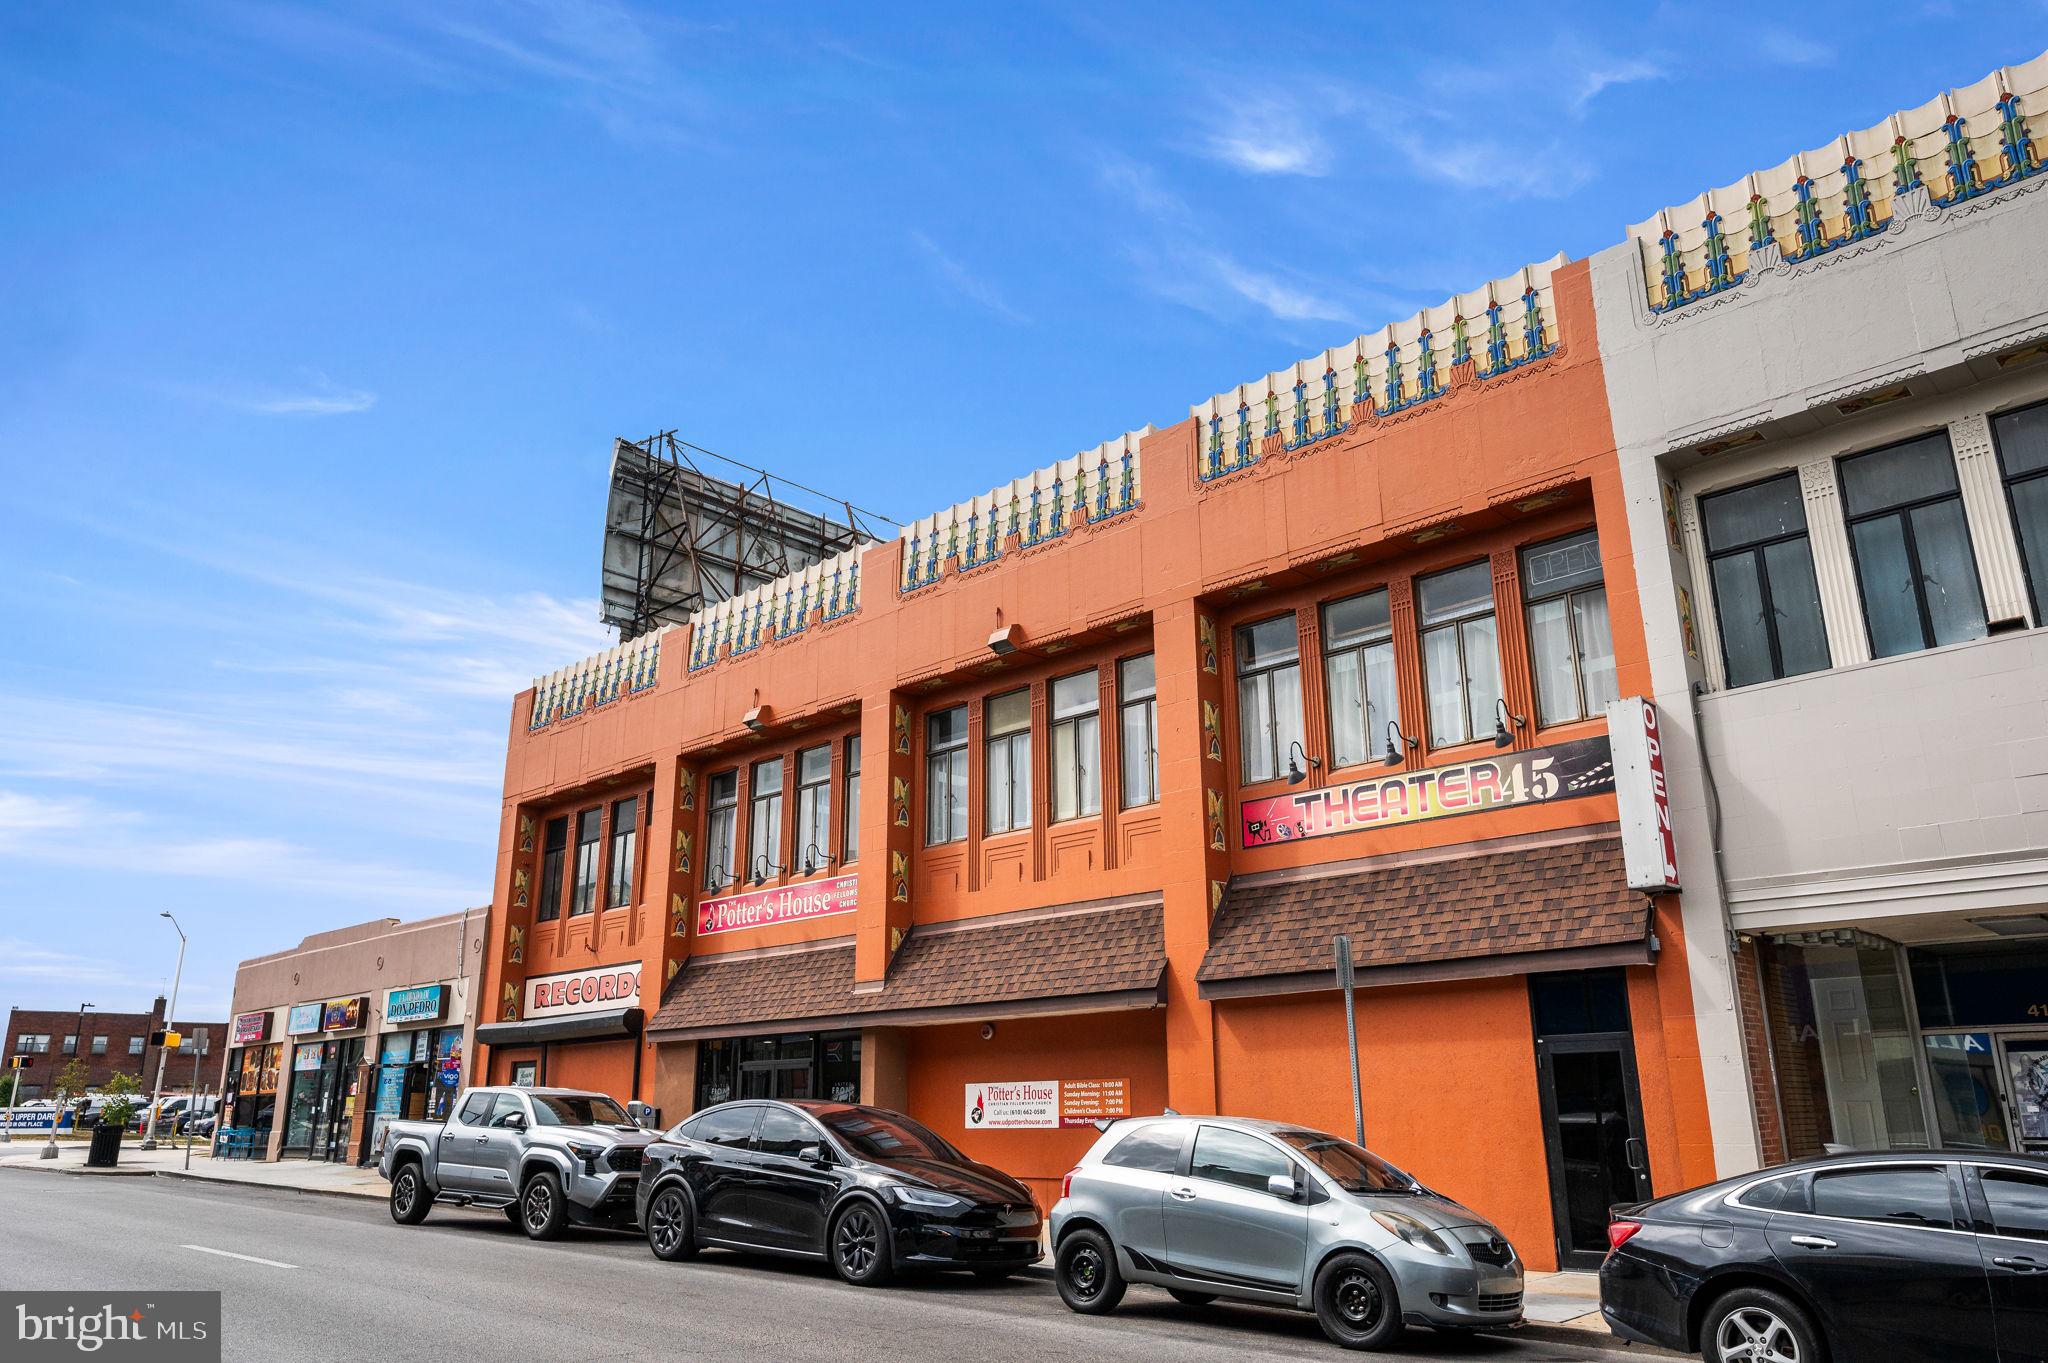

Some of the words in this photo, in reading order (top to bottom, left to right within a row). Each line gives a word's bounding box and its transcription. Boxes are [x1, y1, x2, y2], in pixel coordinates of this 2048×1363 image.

[1532, 544, 1601, 581] OPEN
[1643, 703, 1672, 831] OPEN
[1294, 761, 1503, 832] THEATER
[1500, 756, 1559, 803] 45
[836, 879, 858, 889] CHRISTI
[833, 888, 858, 899] FELLOWS
[839, 899, 858, 908] CHURC
[717, 895, 773, 928] Potter's
[778, 890, 831, 918] House
[408, 1000, 437, 1015] PEDRO
[443, 1073, 459, 1081] vigo
[988, 1085, 1021, 1101] Potter's
[1023, 1084, 1053, 1100] House
[1080, 1090, 1100, 1098] Morning:
[1081, 1099, 1100, 1107] Evening:
[645, 1107, 651, 1115] P
[15, 1113, 36, 1121] UPPER
